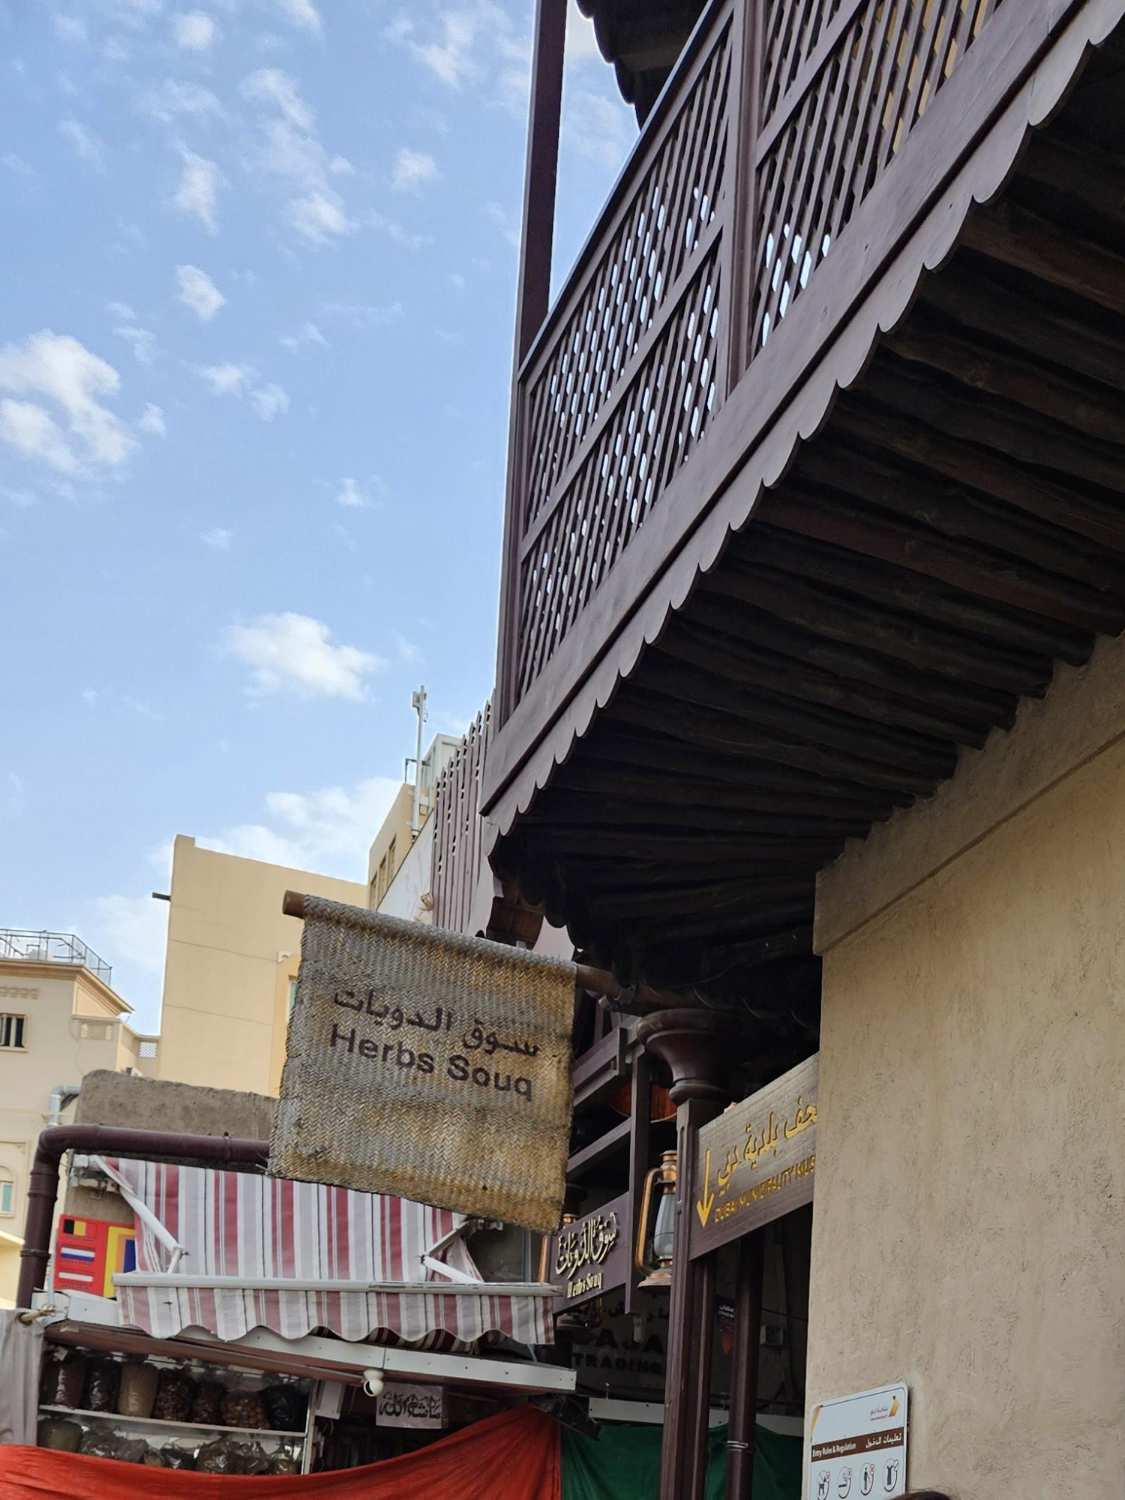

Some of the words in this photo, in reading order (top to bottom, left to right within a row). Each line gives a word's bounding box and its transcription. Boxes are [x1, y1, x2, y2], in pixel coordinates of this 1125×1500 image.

[461, 1018, 540, 1058] سوق
[329, 1023, 436, 1074] Herbs
[446, 1054, 534, 1101] Souq
[784, 1095, 817, 1139] حف
[743, 1111, 780, 1171] بلدية
[795, 1154, 815, 1180] MUS
